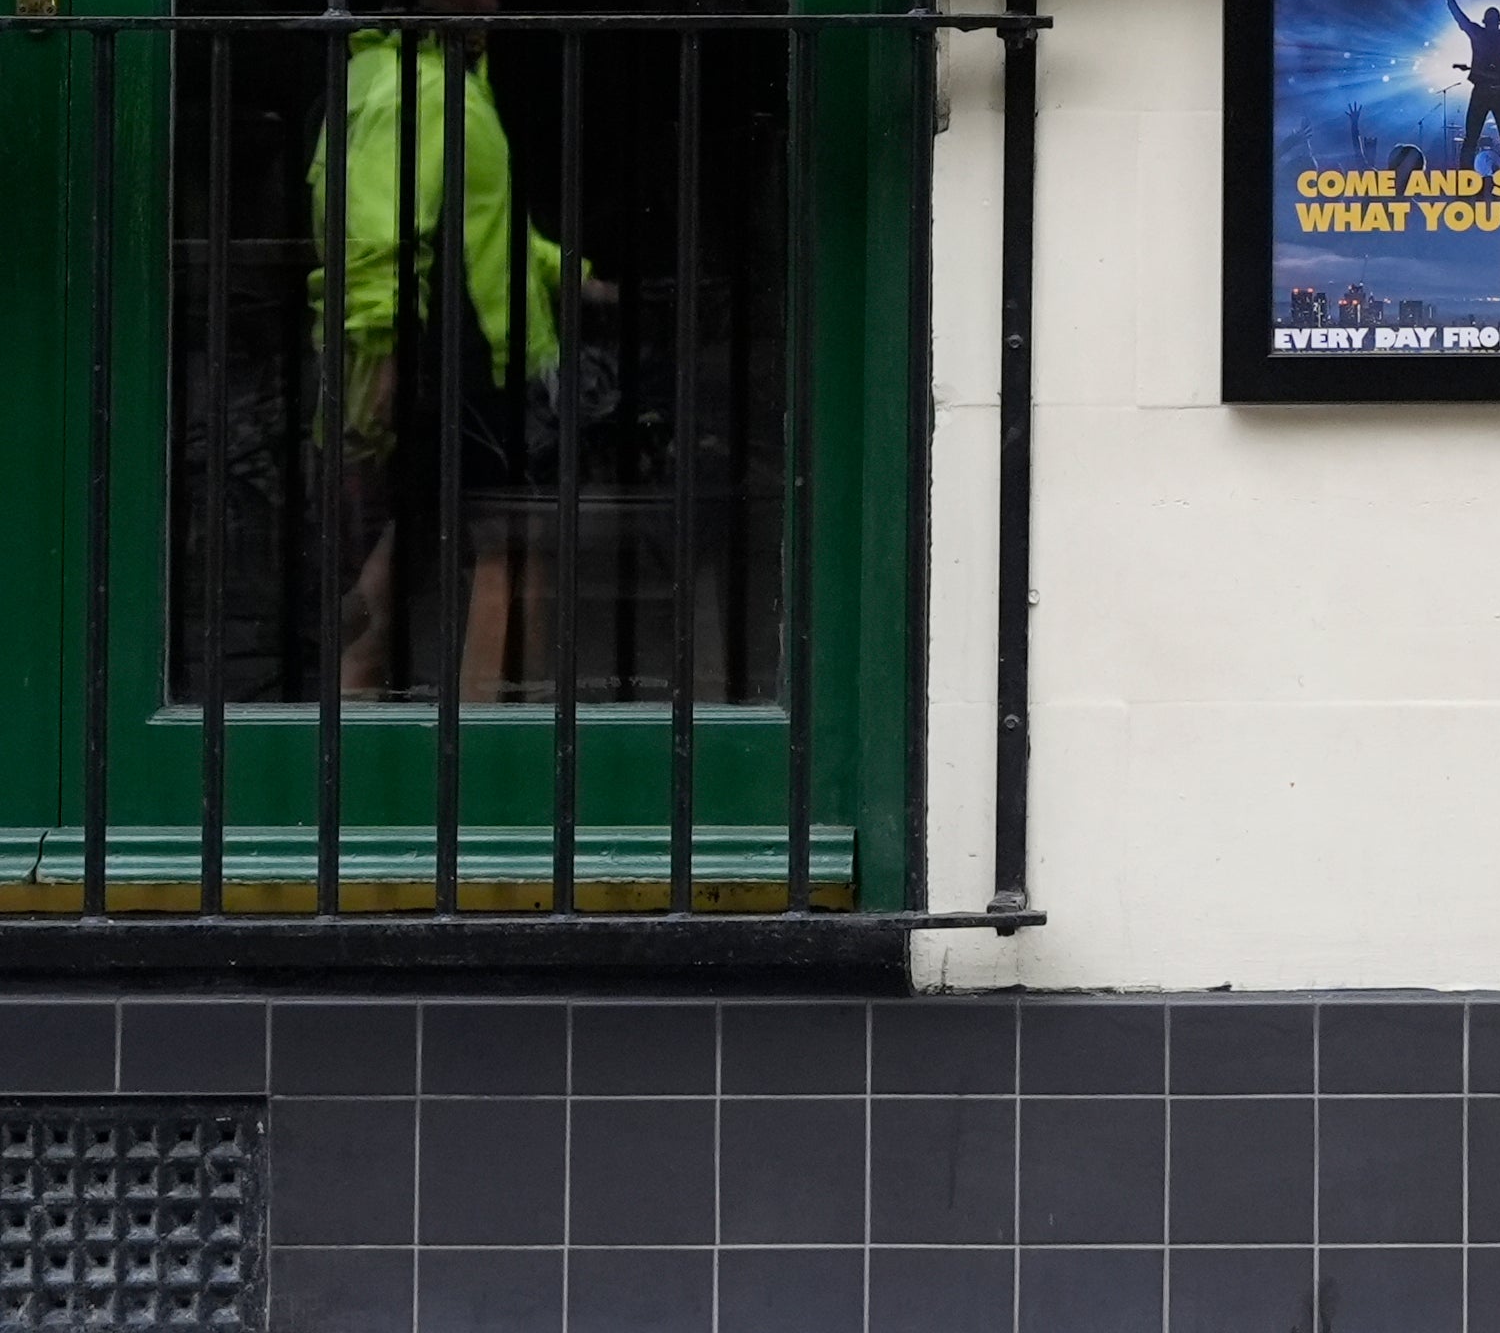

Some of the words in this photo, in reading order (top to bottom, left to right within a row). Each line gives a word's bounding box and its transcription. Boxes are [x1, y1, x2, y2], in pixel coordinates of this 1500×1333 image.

[1297, 170, 1396, 197] COME
[1404, 169, 1483, 197] AND
[1295, 202, 1410, 232] WHAT
[1274, 327, 1370, 349] EVERY
[1375, 327, 1437, 349] DAY
